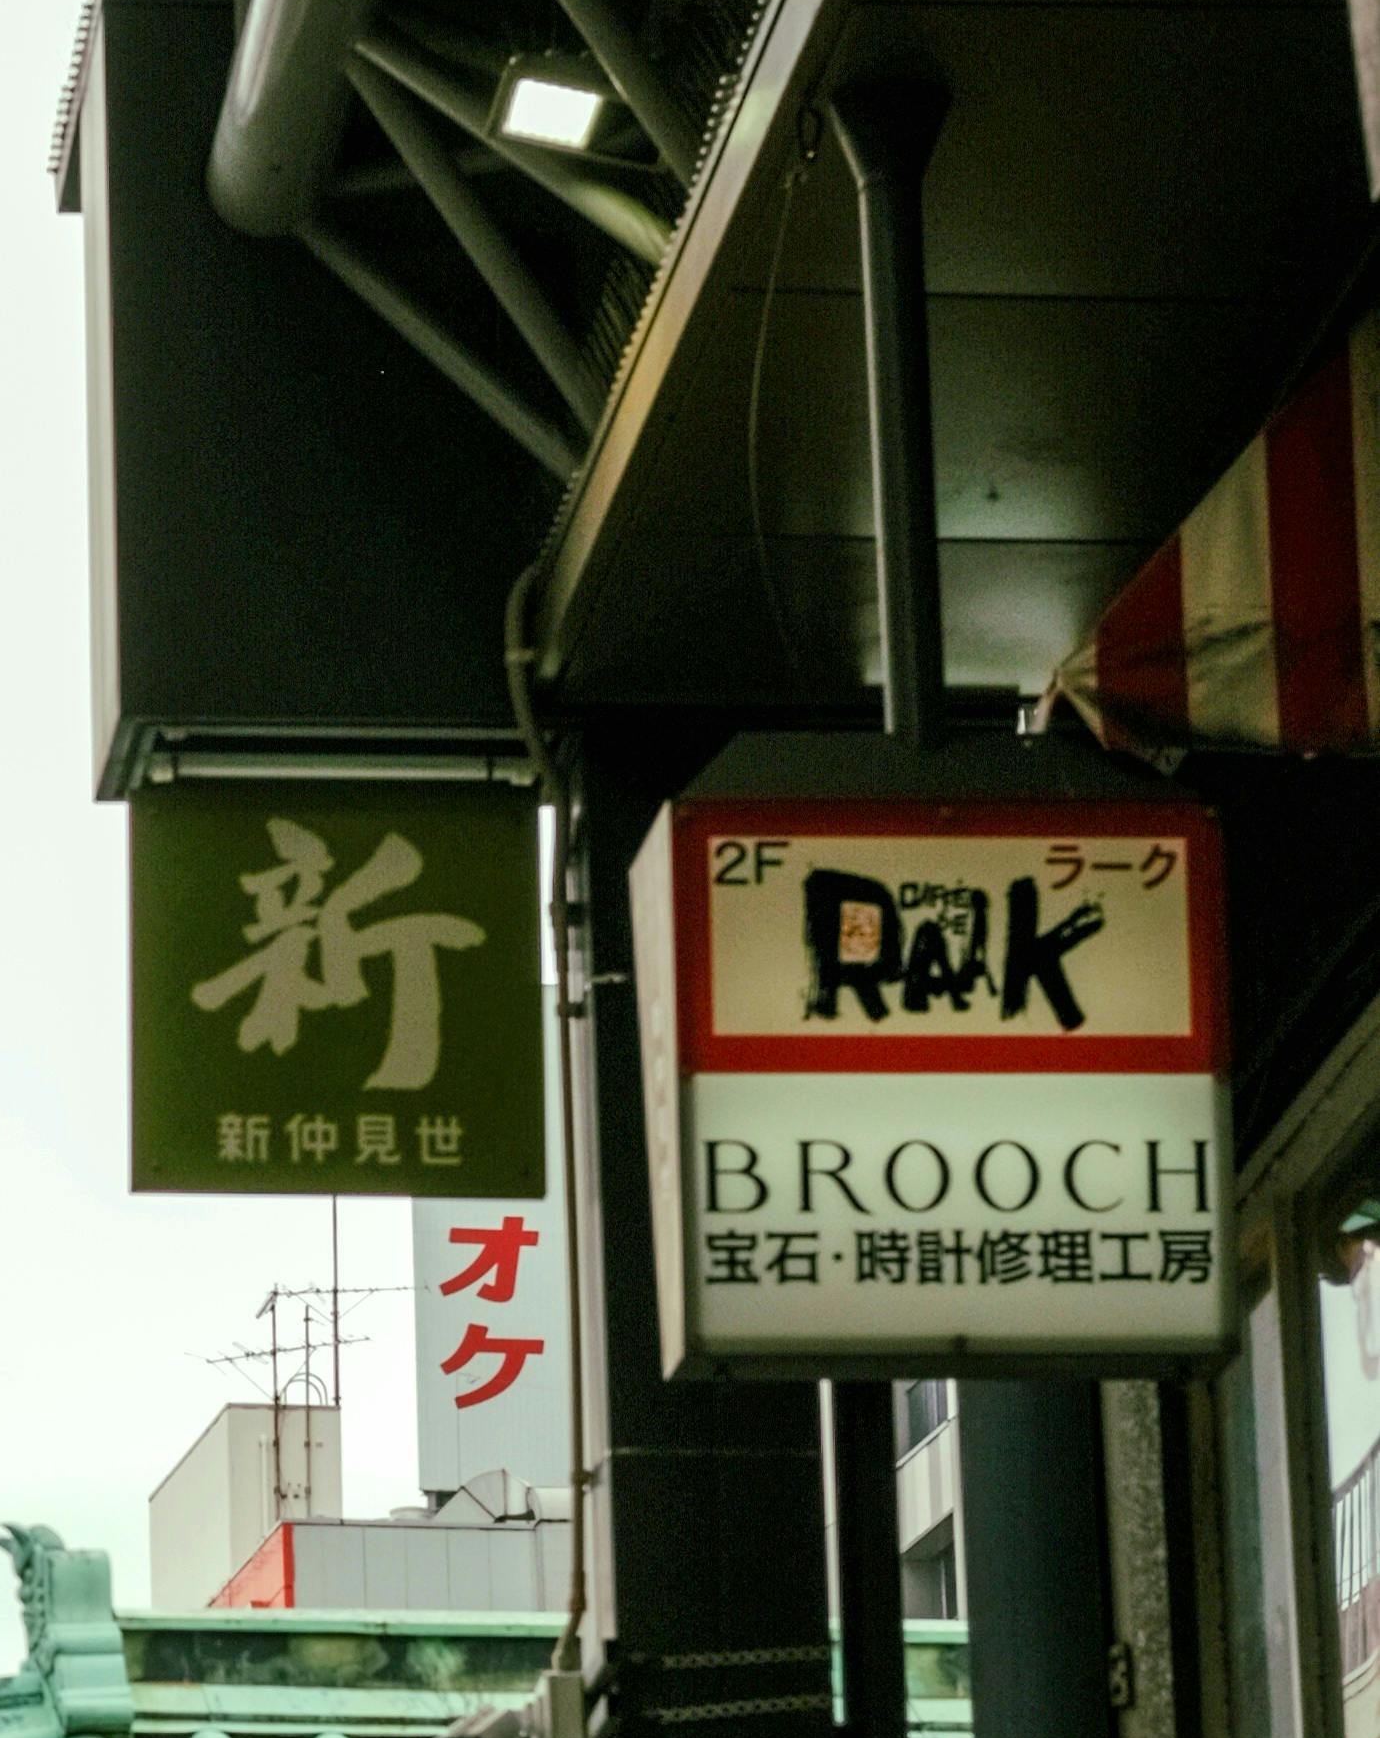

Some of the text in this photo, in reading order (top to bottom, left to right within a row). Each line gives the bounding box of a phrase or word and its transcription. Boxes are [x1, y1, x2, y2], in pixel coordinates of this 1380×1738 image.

[714, 842, 1177, 890] 2F ラーク
[193, 818, 486, 1091] 新
[218, 1114, 463, 1167] 新仲見世
[704, 1140, 1212, 1216] BROOCH
